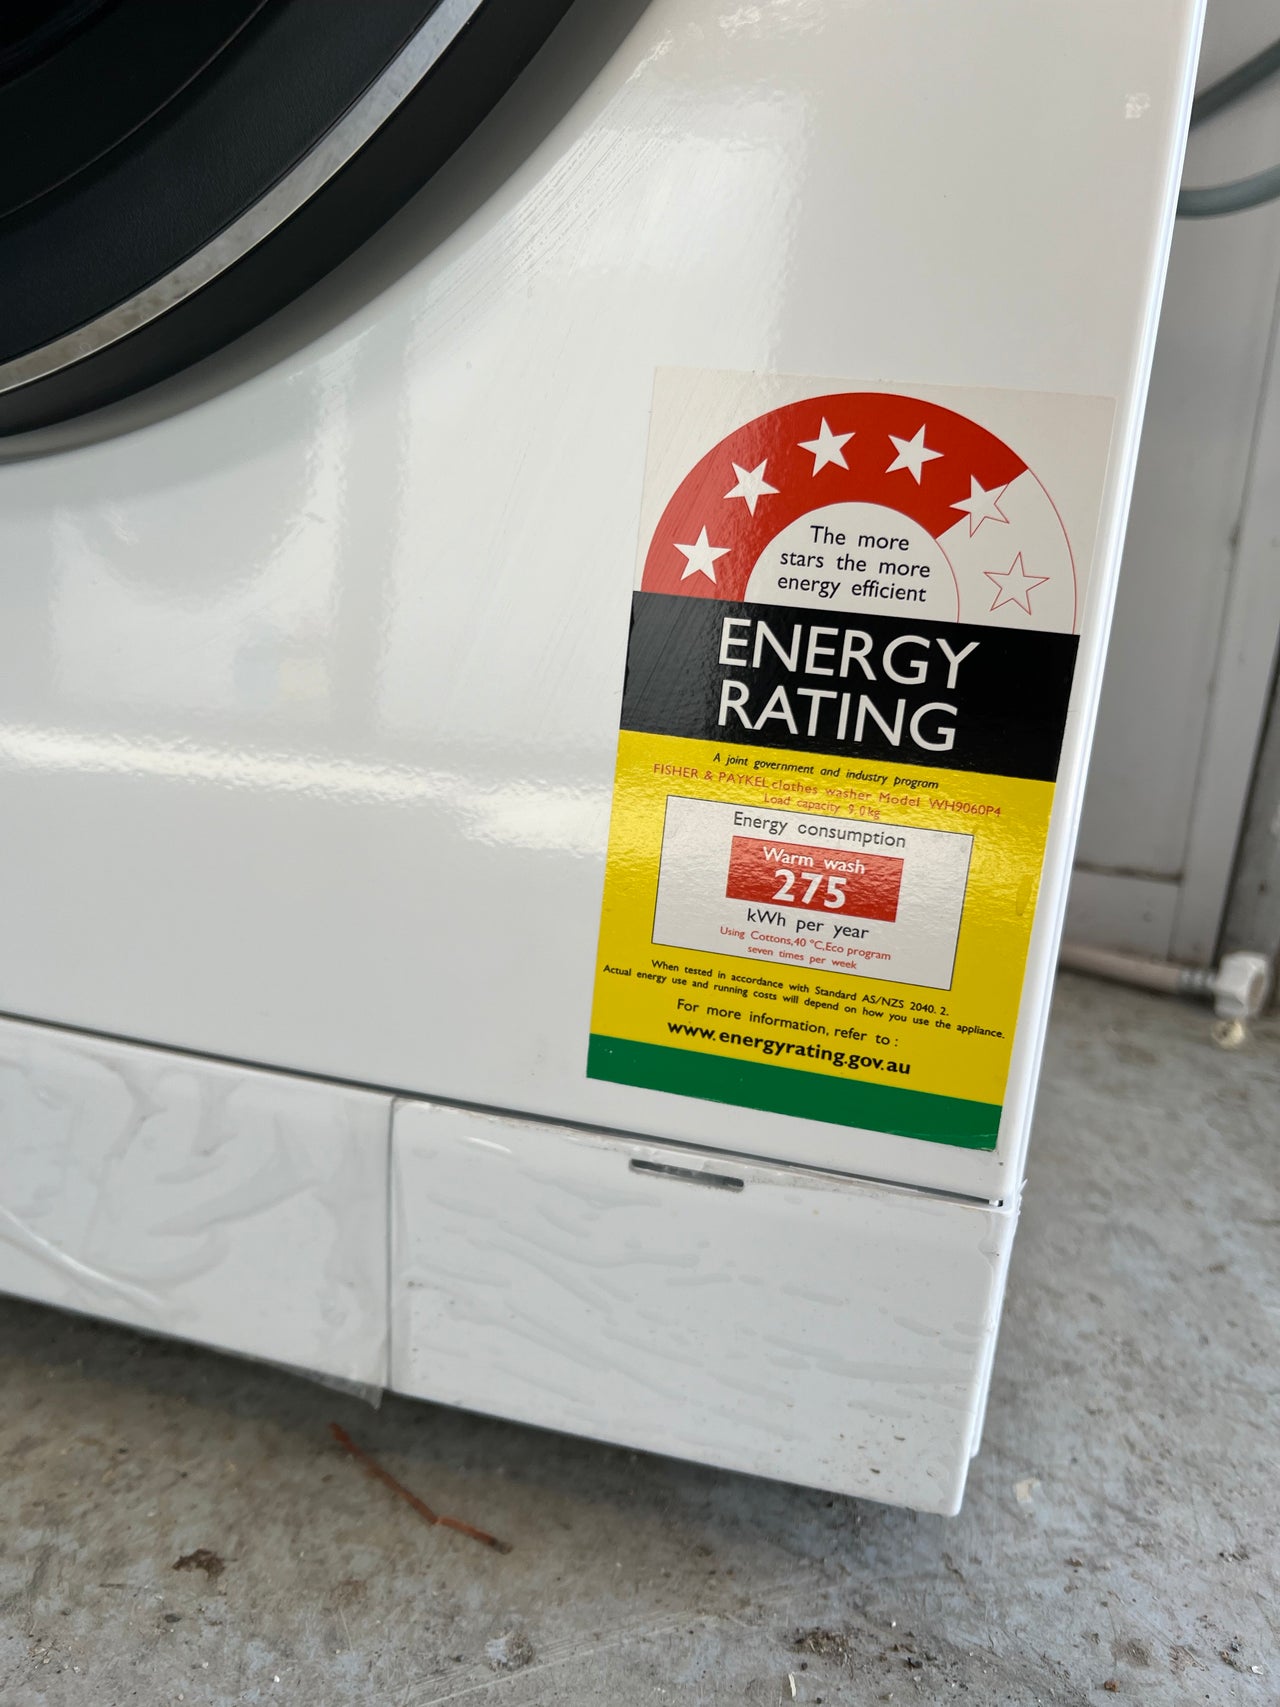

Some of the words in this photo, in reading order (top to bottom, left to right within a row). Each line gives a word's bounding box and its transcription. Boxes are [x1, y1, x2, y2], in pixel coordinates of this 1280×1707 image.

[810, 525, 846, 547] The
[857, 535, 910, 551] more
[780, 549, 825, 568] stars
[836, 554, 867, 572] the
[878, 562, 931, 578] more
[777, 577, 840, 599] energy
[851, 579, 927, 603] efficient
[718, 617, 981, 690] ENERGY
[717, 679, 959, 752] RATING
[653, 763, 699, 780] FISHER
[704, 770, 713, 780] &
[824, 785, 872, 801] washer
[879, 791, 921, 807] Model
[929, 797, 1002, 817] WH9060P4
[713, 753, 721, 763] A
[725, 754, 749, 767] joint
[753, 759, 815, 775] government
[820, 766, 841, 778] and
[846, 768, 888, 786] industry
[893, 775, 940, 791] program
[764, 793, 792, 806] Load
[796, 797, 840, 814] capacity
[734, 811, 788, 835] Energy
[798, 820, 906, 848] consumption
[763, 846, 814, 868] Warm
[823, 858, 866, 875] wash
[772, 869, 847, 909] 275
[747, 909, 787, 927] kWh
[796, 918, 824, 933] per
[834, 925, 870, 940] year
[720, 926, 745, 940] Using
[847, 946, 891, 962] program
[747, 946, 774, 957] seven
[779, 949, 804, 961] times
[809, 954, 827, 966] per
[831, 957, 857, 970] week
[603, 964, 632, 977] Actual
[636, 971, 667, 984] energy
[671, 976, 688, 986] use
[692, 978, 709, 989] and
[713, 983, 749, 998] running
[753, 989, 778, 1001] costs
[782, 991, 799, 1005] will
[803, 997, 839, 1012] depend
[844, 1005, 858, 1014] on
[862, 1006, 884, 1018] how
[888, 1012, 907, 1023] you
[912, 1016, 930, 1026] use
[935, 1017, 951, 1030] the
[955, 1023, 1006, 1040] appliance.
[651, 959, 680, 973] When
[684, 964, 713, 977] tested
[718, 969, 726, 979] in
[730, 971, 784, 989] accordance
[789, 980, 810, 993] with
[814, 985, 857, 1002] Standard
[861, 992, 904, 1009] AS/NZS
[676, 998, 700, 1013] For
[706, 1004, 743, 1020] more
[749, 1009, 829, 1036] information,
[834, 1026, 868, 1042] refer
[875, 1033, 890, 1046] to
[667, 1022, 911, 1076] www.energyrating.gov.au
